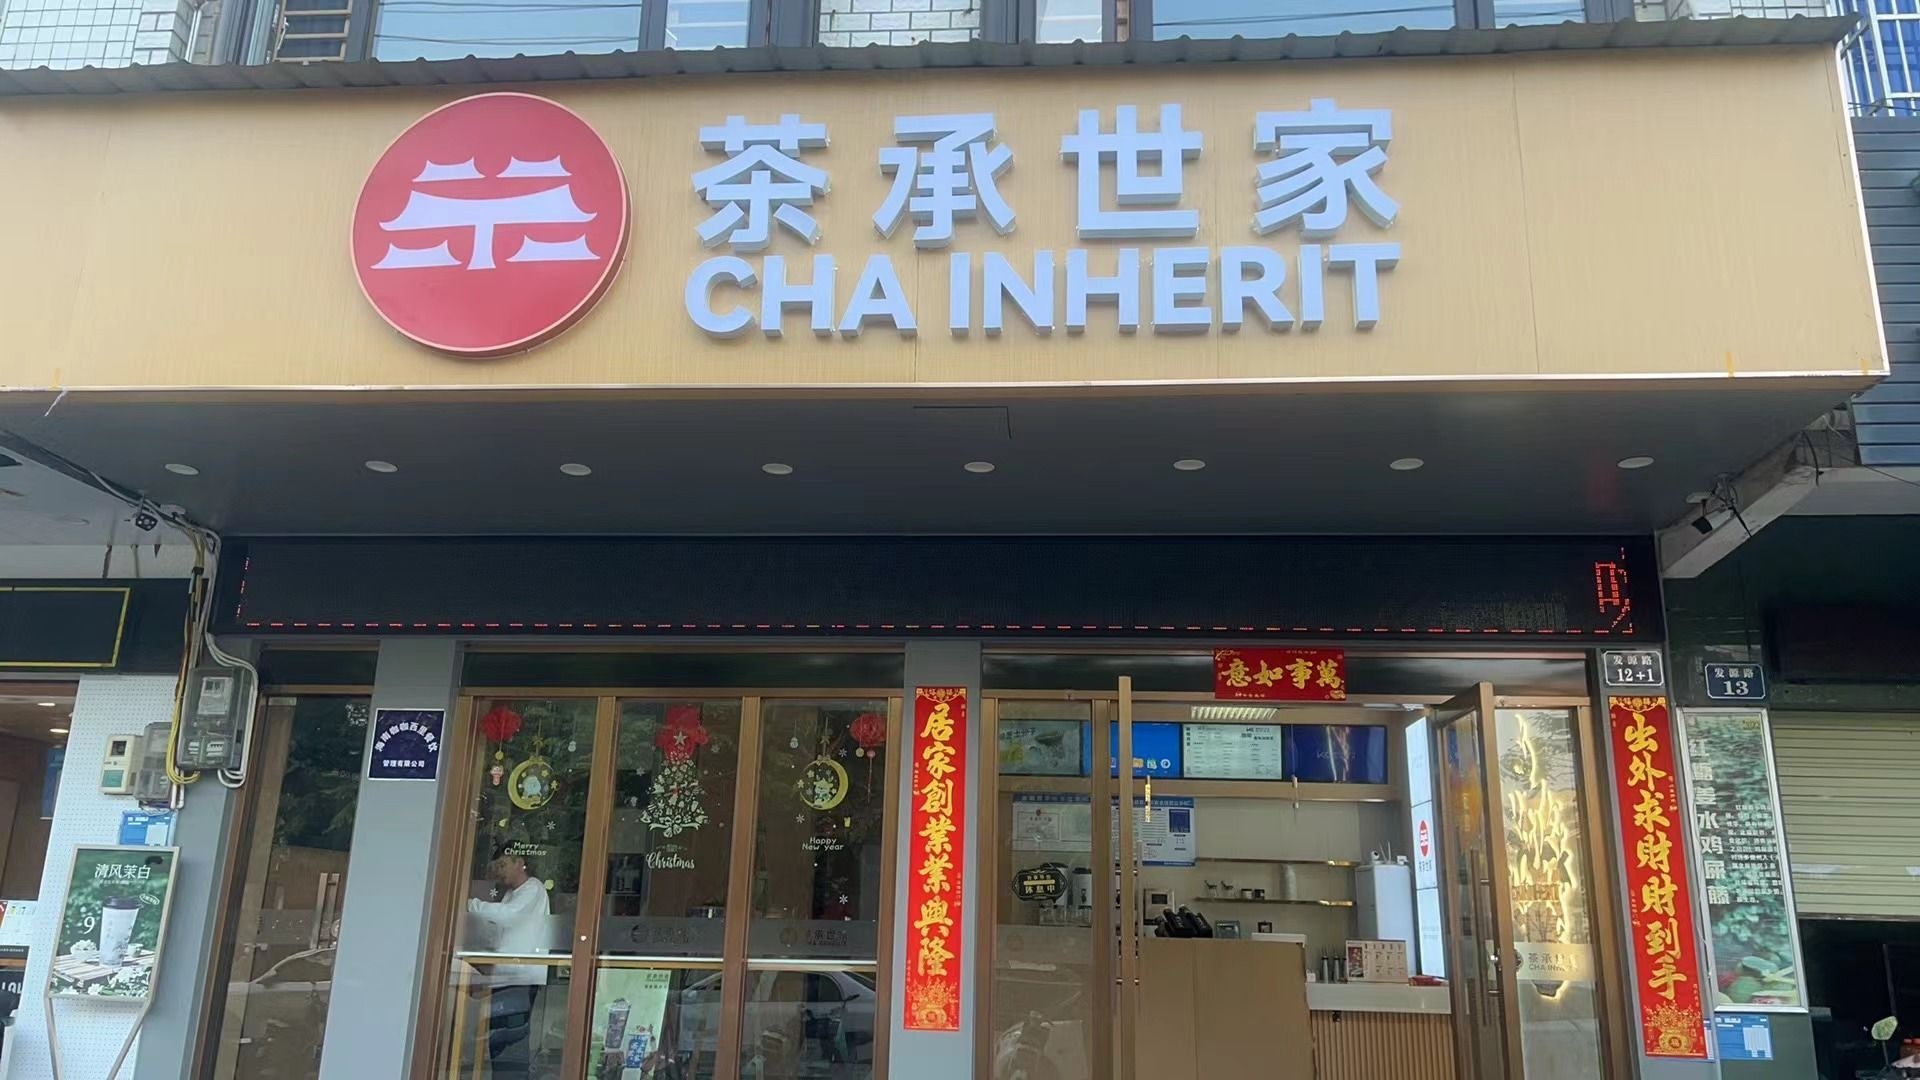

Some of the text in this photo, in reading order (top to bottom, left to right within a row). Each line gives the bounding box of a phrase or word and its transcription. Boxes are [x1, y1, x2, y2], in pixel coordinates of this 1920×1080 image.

[690, 98, 1400, 251] 茶承世家
[685, 243, 1400, 337] CHA INHERIT
[1617, 668, 1655, 682] 12+1
[1723, 681, 1749, 695] 13
[514, 841, 539, 850] Merry
[810, 837, 837, 846] Happy
[504, 847, 548, 856] Christmas
[1624, 712, 1687, 1000] 出外求財財到手
[646, 851, 695, 869] Christmas
[95, 863, 151, 879] 清风茉白
